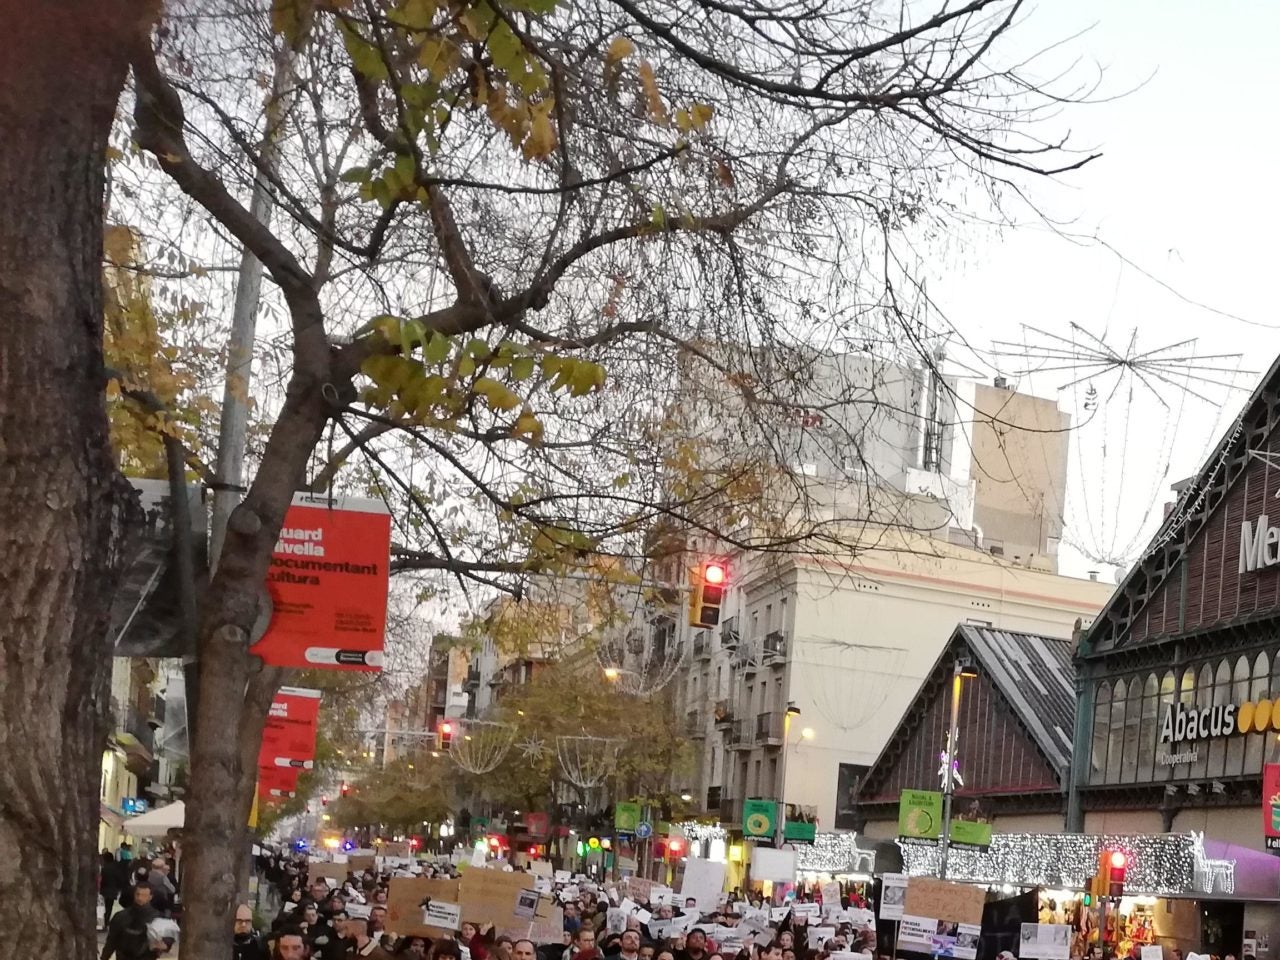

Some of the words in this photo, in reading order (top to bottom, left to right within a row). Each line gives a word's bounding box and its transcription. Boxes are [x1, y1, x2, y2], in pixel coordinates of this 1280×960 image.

[270, 557, 378, 576] ocumentant
[1160, 702, 1236, 743] Abacus
[1161, 748, 1199, 767] Cooperativa
